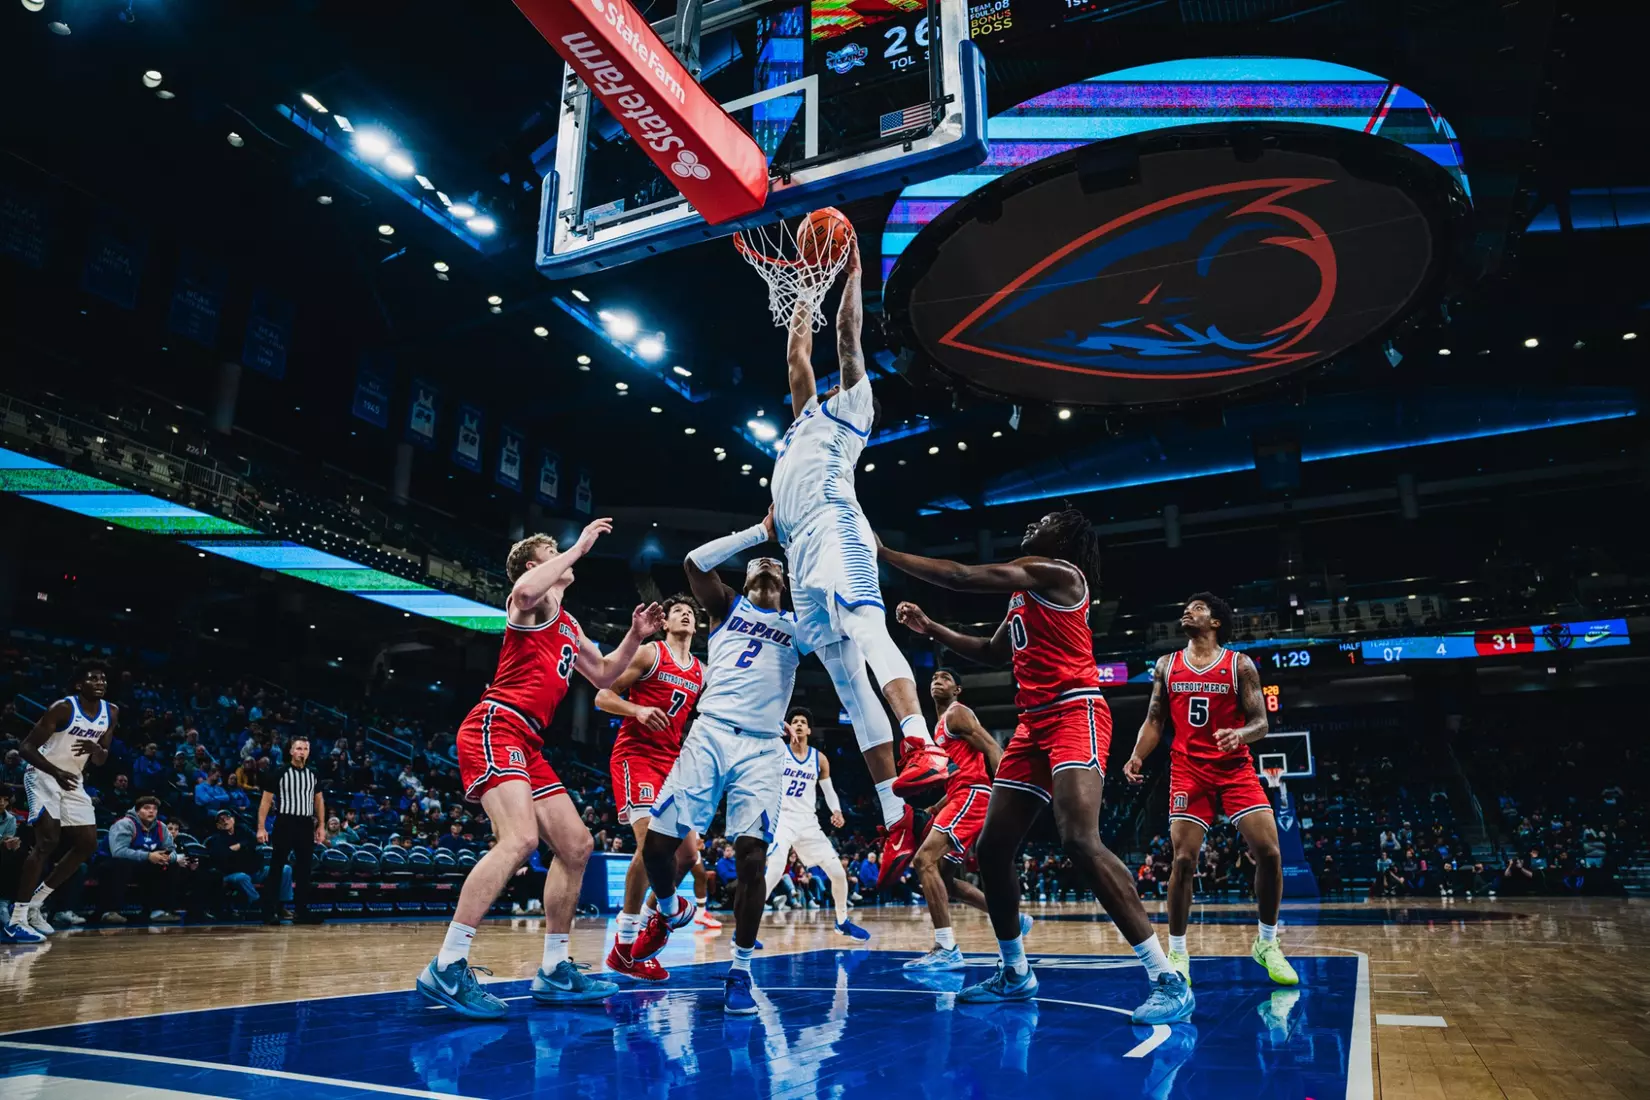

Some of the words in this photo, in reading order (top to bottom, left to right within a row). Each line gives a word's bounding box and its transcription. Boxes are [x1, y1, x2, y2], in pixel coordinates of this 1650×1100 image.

[969, 3, 991, 13] TEAM
[969, 8, 995, 20] FOULS
[970, 9, 1012, 27] BONUS
[970, 18, 1013, 39] POSS
[889, 55, 916, 70] TOL
[1339, 642, 1361, 651] HALF
[1436, 643, 1447, 656] 4
[1492, 632, 1517, 650] 31
[734, 639, 763, 669] 2
[1271, 650, 1310, 668] 1:29
[1348, 652, 1356, 664] 1
[1383, 646, 1403, 661] 07
[1171, 681, 1202, 693] DETROIT
[1203, 682, 1230, 694] MERCY
[667, 688, 688, 717] 7
[1267, 695, 1278, 712] 8
[1188, 696, 1209, 727] 5
[786, 780, 806, 797] 22
